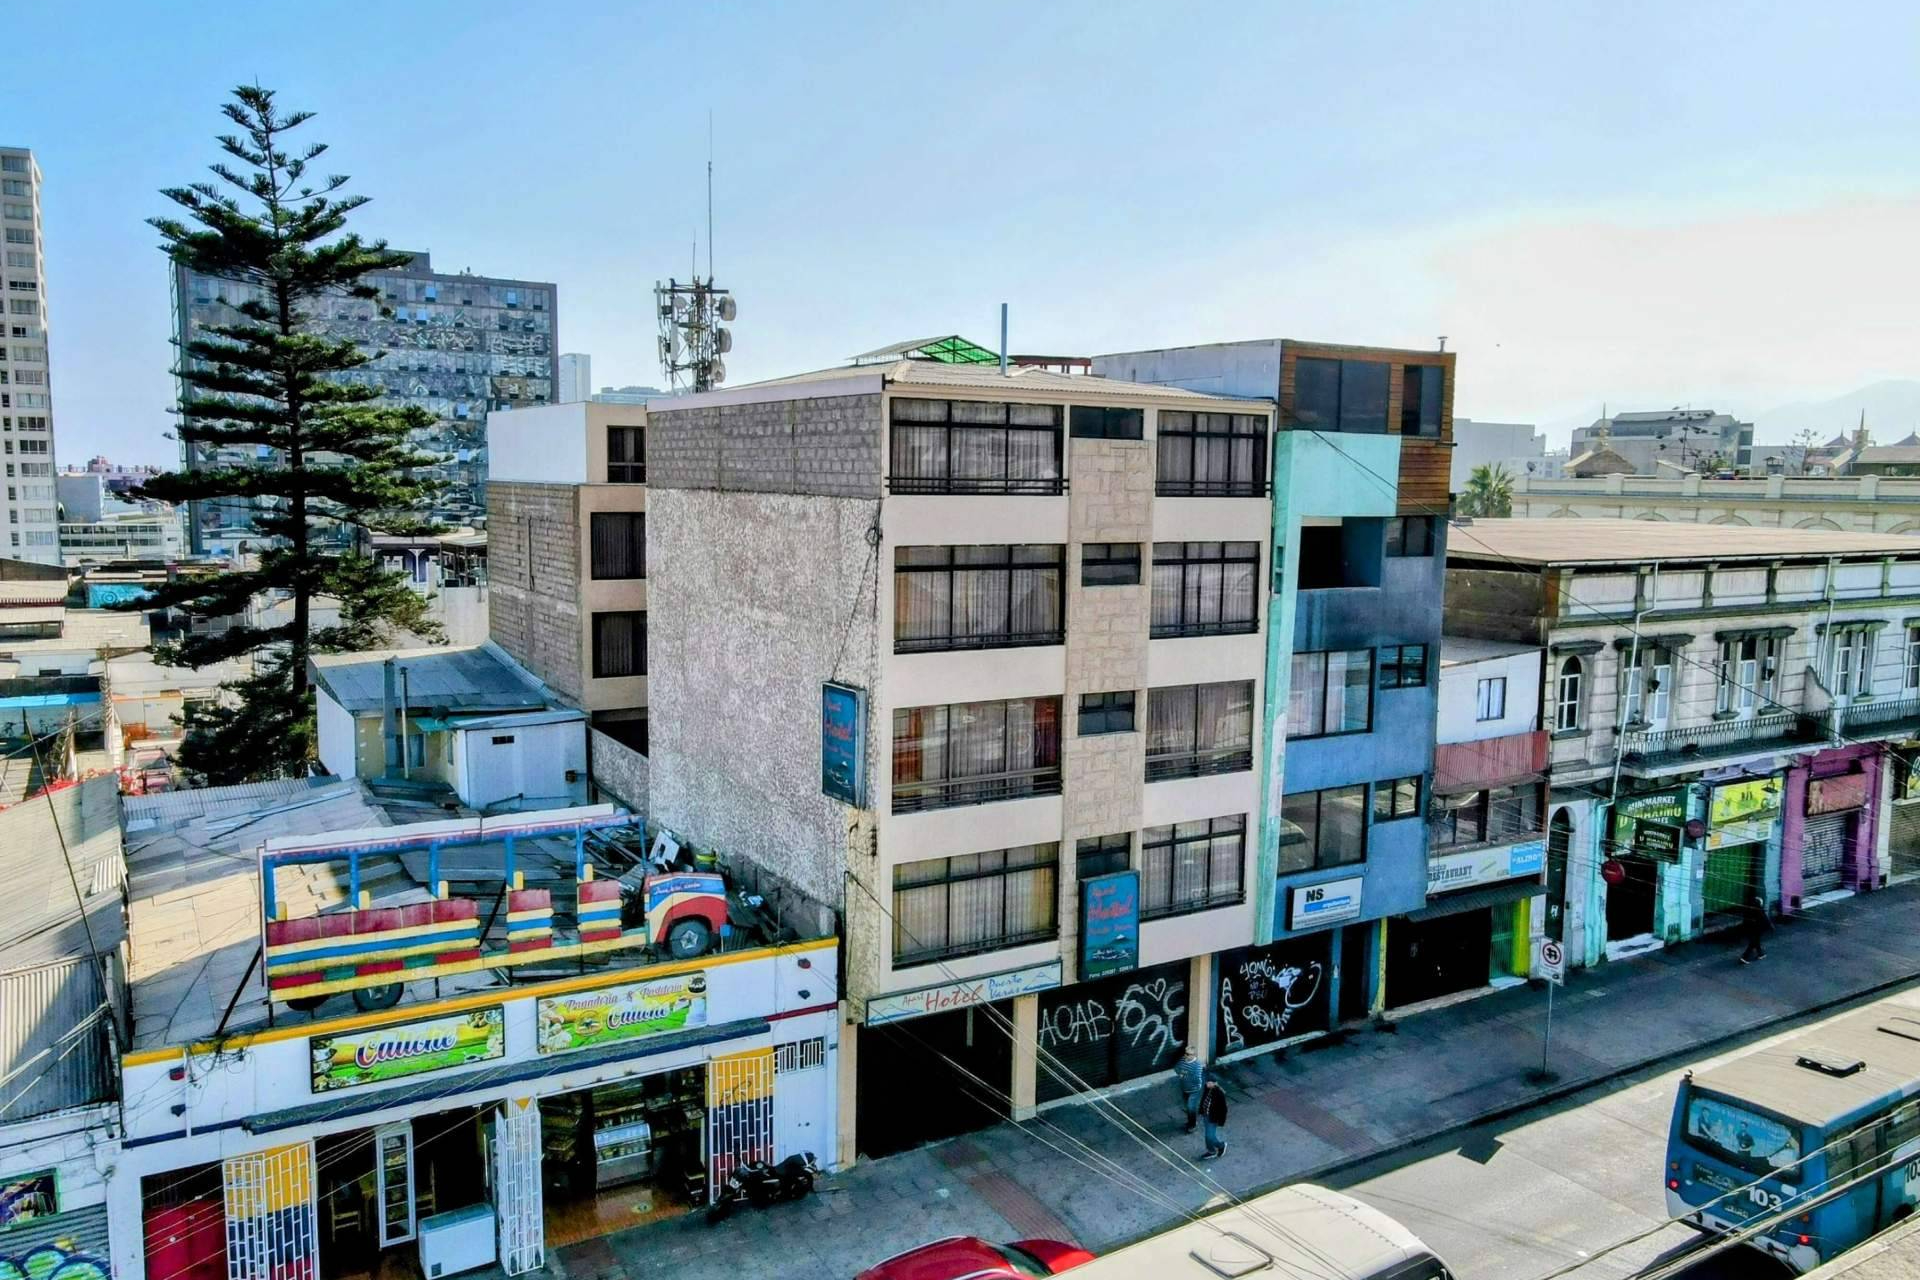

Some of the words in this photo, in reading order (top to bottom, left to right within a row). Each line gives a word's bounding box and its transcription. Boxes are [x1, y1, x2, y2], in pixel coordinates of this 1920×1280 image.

[1306, 889, 1324, 902] NS
[925, 984, 984, 1013] Hotel
[1746, 1185, 1783, 1213] 103
